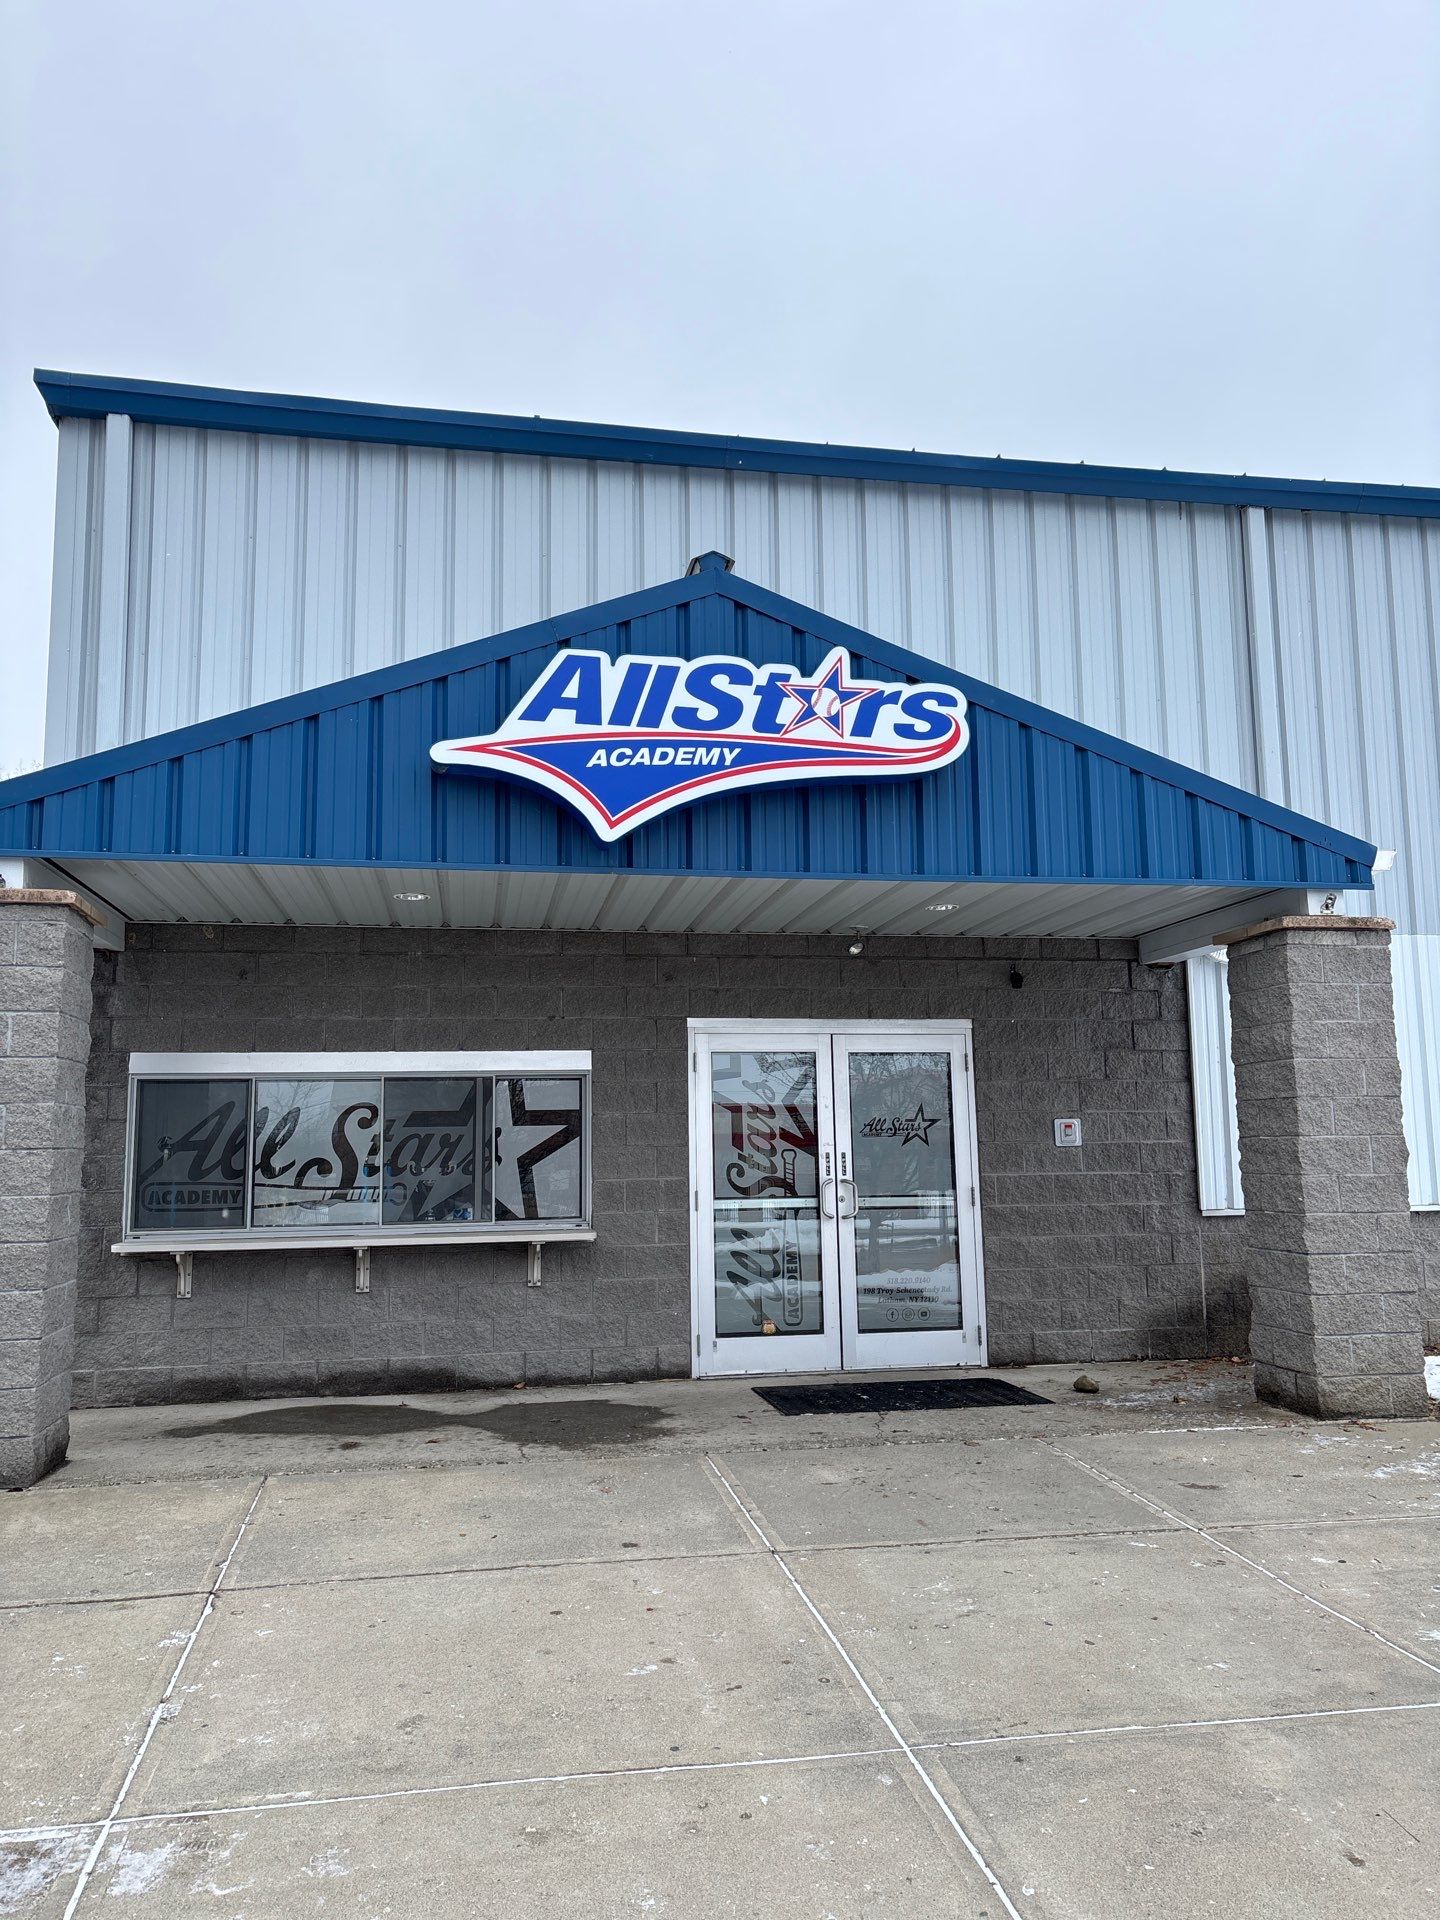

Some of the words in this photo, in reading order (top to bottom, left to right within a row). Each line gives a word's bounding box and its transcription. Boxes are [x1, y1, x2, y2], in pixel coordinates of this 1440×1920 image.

[586, 746, 742, 767] ACADEMY
[860, 1116, 887, 1133] All
[886, 1117, 922, 1137] Stars
[139, 1101, 296, 1184] All
[294, 1102, 503, 1211] Stars
[148, 1189, 242, 1206] ACADEMY
[786, 1240, 800, 1320] ACADEMY
[863, 1287, 876, 1295] 198
[877, 1287, 894, 1296] Troy
[941, 1285, 953, 1293] Rd.
